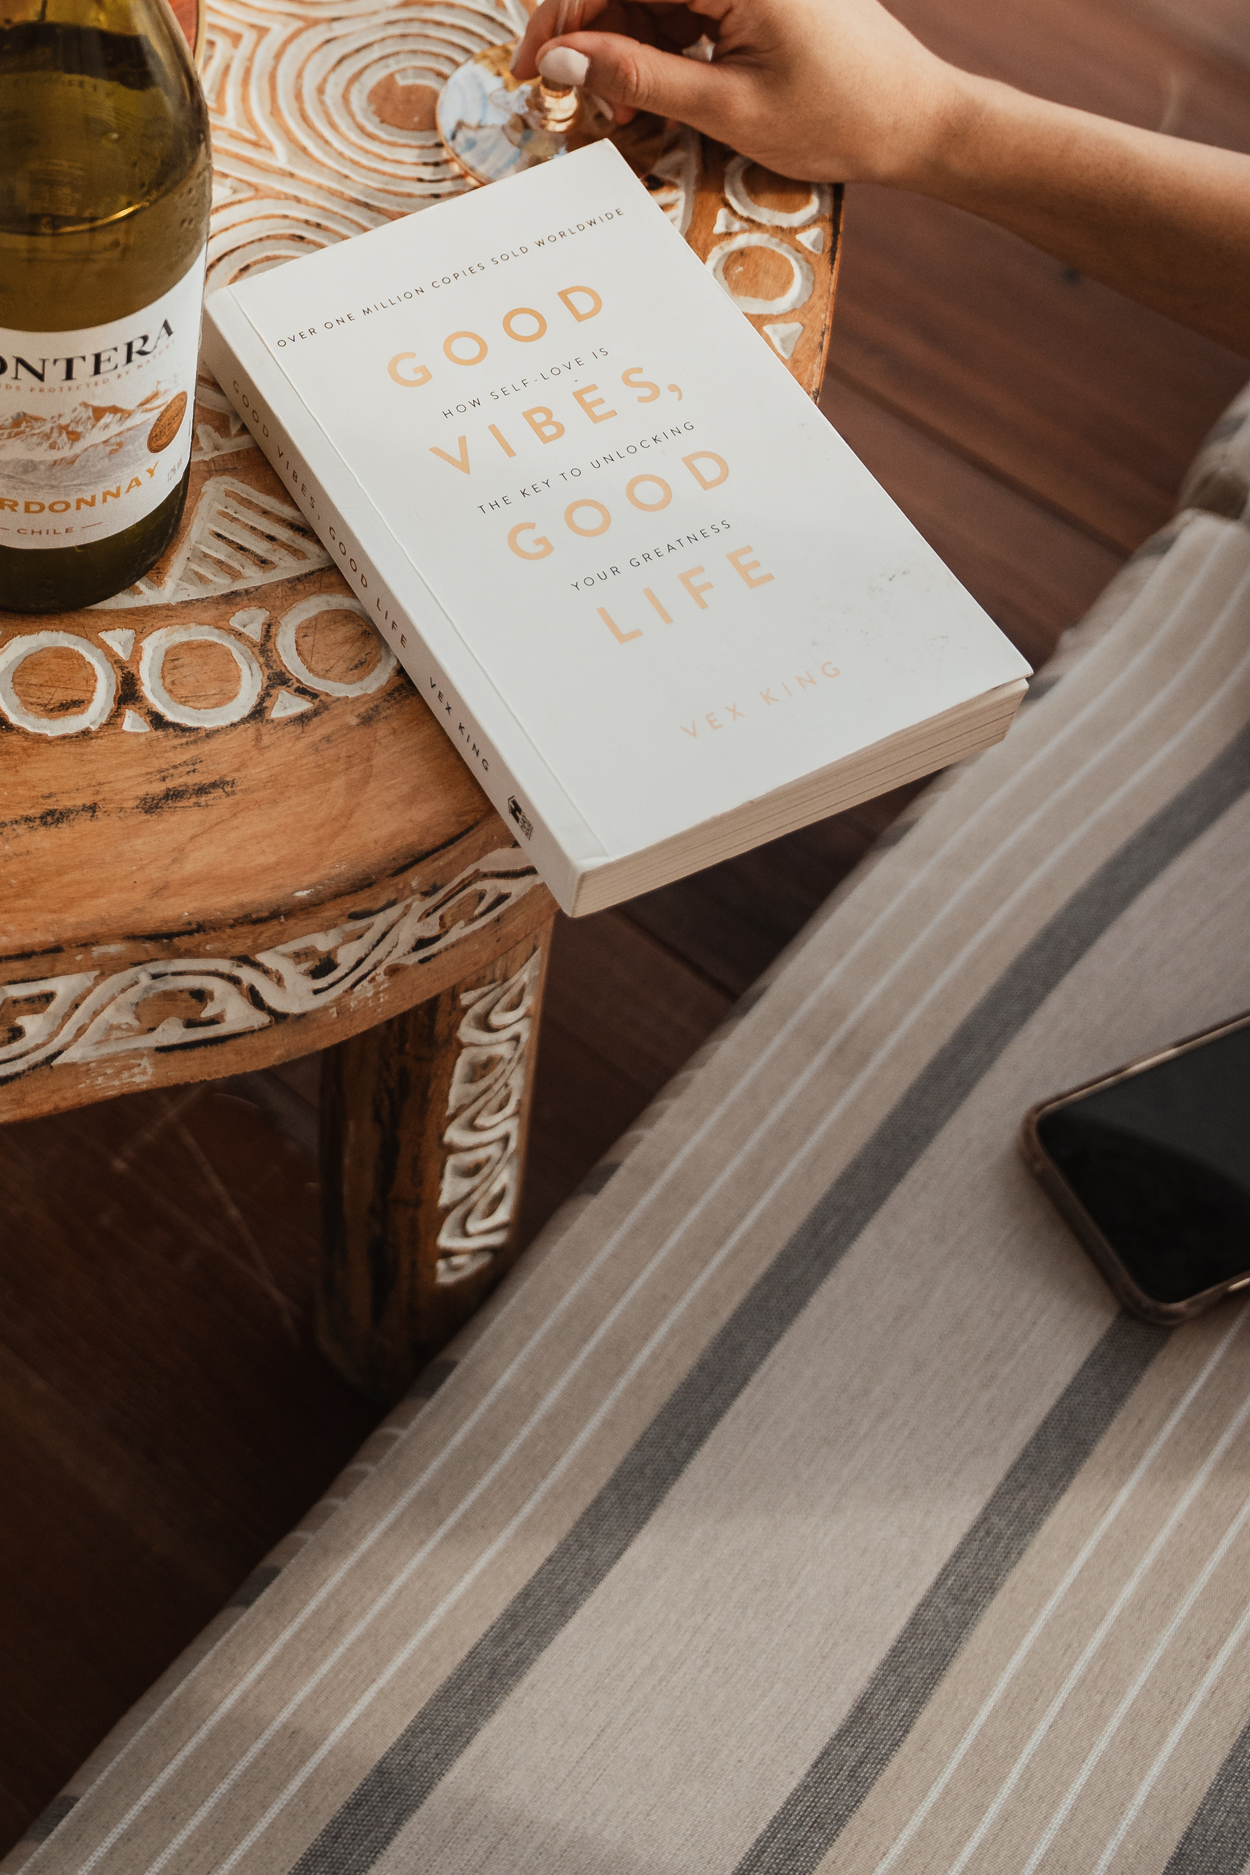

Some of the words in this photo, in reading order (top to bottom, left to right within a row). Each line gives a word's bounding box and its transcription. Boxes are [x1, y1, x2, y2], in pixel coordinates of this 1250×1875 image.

[277, 327, 318, 348] OVER
[324, 312, 356, 330] ONE
[362, 285, 426, 316] MILLION
[431, 261, 486, 290] COPIES
[491, 245, 529, 265] SOLD
[534, 206, 625, 248] WORLDWIDE
[387, 285, 603, 388] GOOD
[442, 396, 483, 419] HOW
[490, 356, 585, 401] SELF-LOVE
[592, 346, 610, 360] IS
[30, 378, 110, 393] PROTECTED
[428, 367, 684, 475] VIBES,
[477, 495, 513, 515] THE
[519, 478, 553, 499] KEY
[559, 467, 583, 483] TO
[590, 421, 696, 470] UNLOCKING
[507, 450, 730, 561] GOOD
[16, 526, 75, 536] CHILE
[232, 380, 270, 438] GOOD
[276, 445, 322, 521] VIBES,
[328, 526, 369, 589] GOOD
[376, 597, 408, 649] LIFE
[430, 676, 452, 716] VEX
[458, 722, 490, 772] KING
[570, 564, 622, 592] YOUR
[629, 519, 733, 568] GREATNESS
[596, 544, 775, 644] LIFE
[679, 702, 746, 739] VEX
[759, 661, 842, 706] KING
